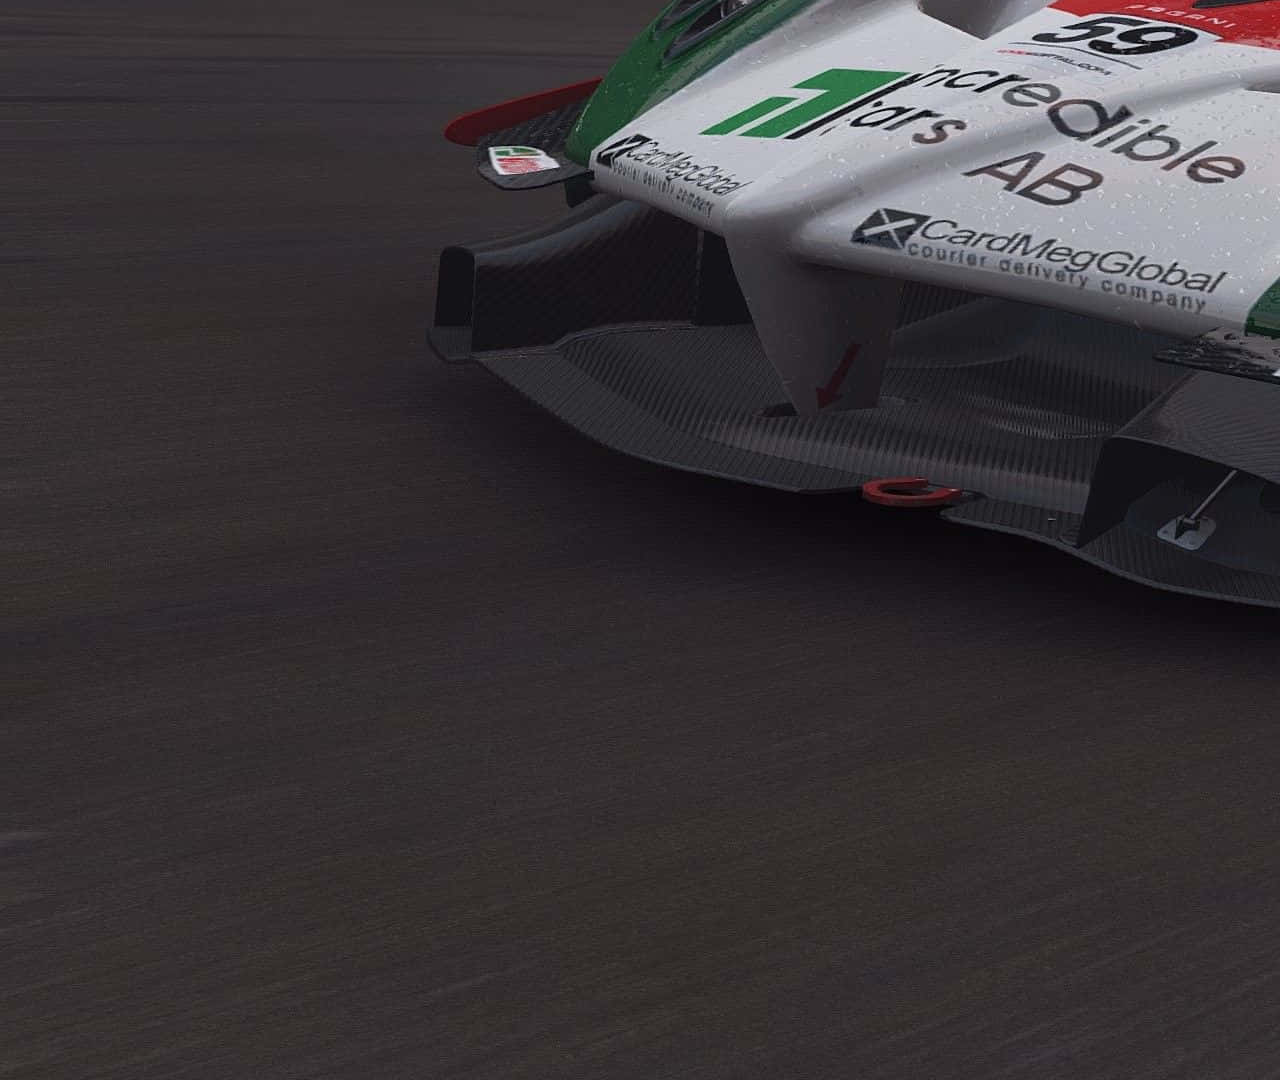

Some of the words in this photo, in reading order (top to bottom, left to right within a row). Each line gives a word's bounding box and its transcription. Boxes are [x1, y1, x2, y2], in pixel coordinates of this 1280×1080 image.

[1031, 16, 1199, 56] 59
[962, 151, 1104, 206] AB
[906, 242, 988, 268] courier
[999, 259, 1089, 290] delivery
[1100, 278, 1207, 314] company
[918, 219, 1228, 294] CardMegGlobal
